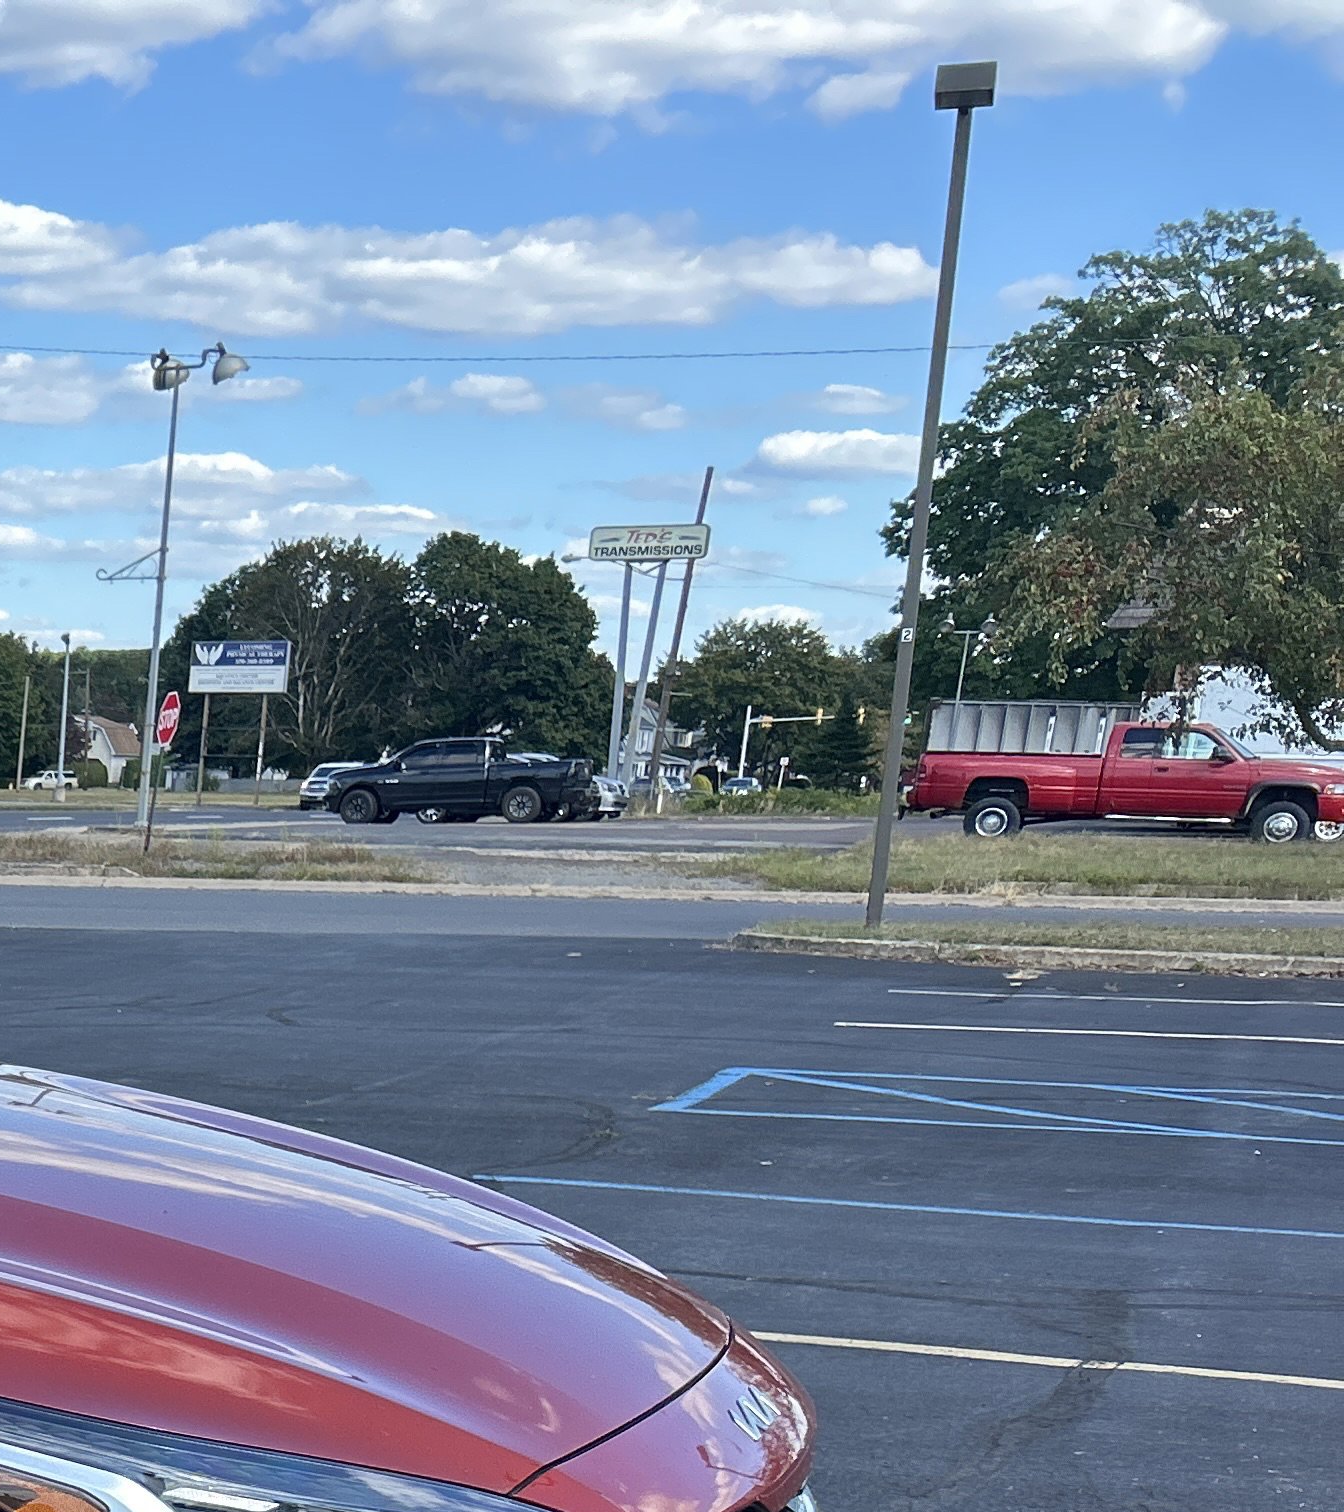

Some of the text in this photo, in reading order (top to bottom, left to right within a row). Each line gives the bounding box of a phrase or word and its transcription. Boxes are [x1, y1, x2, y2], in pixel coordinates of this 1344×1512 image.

[593, 545, 703, 557] TRANSMISSIONS
[903, 629, 912, 641] 2
[158, 708, 179, 730] STOP
